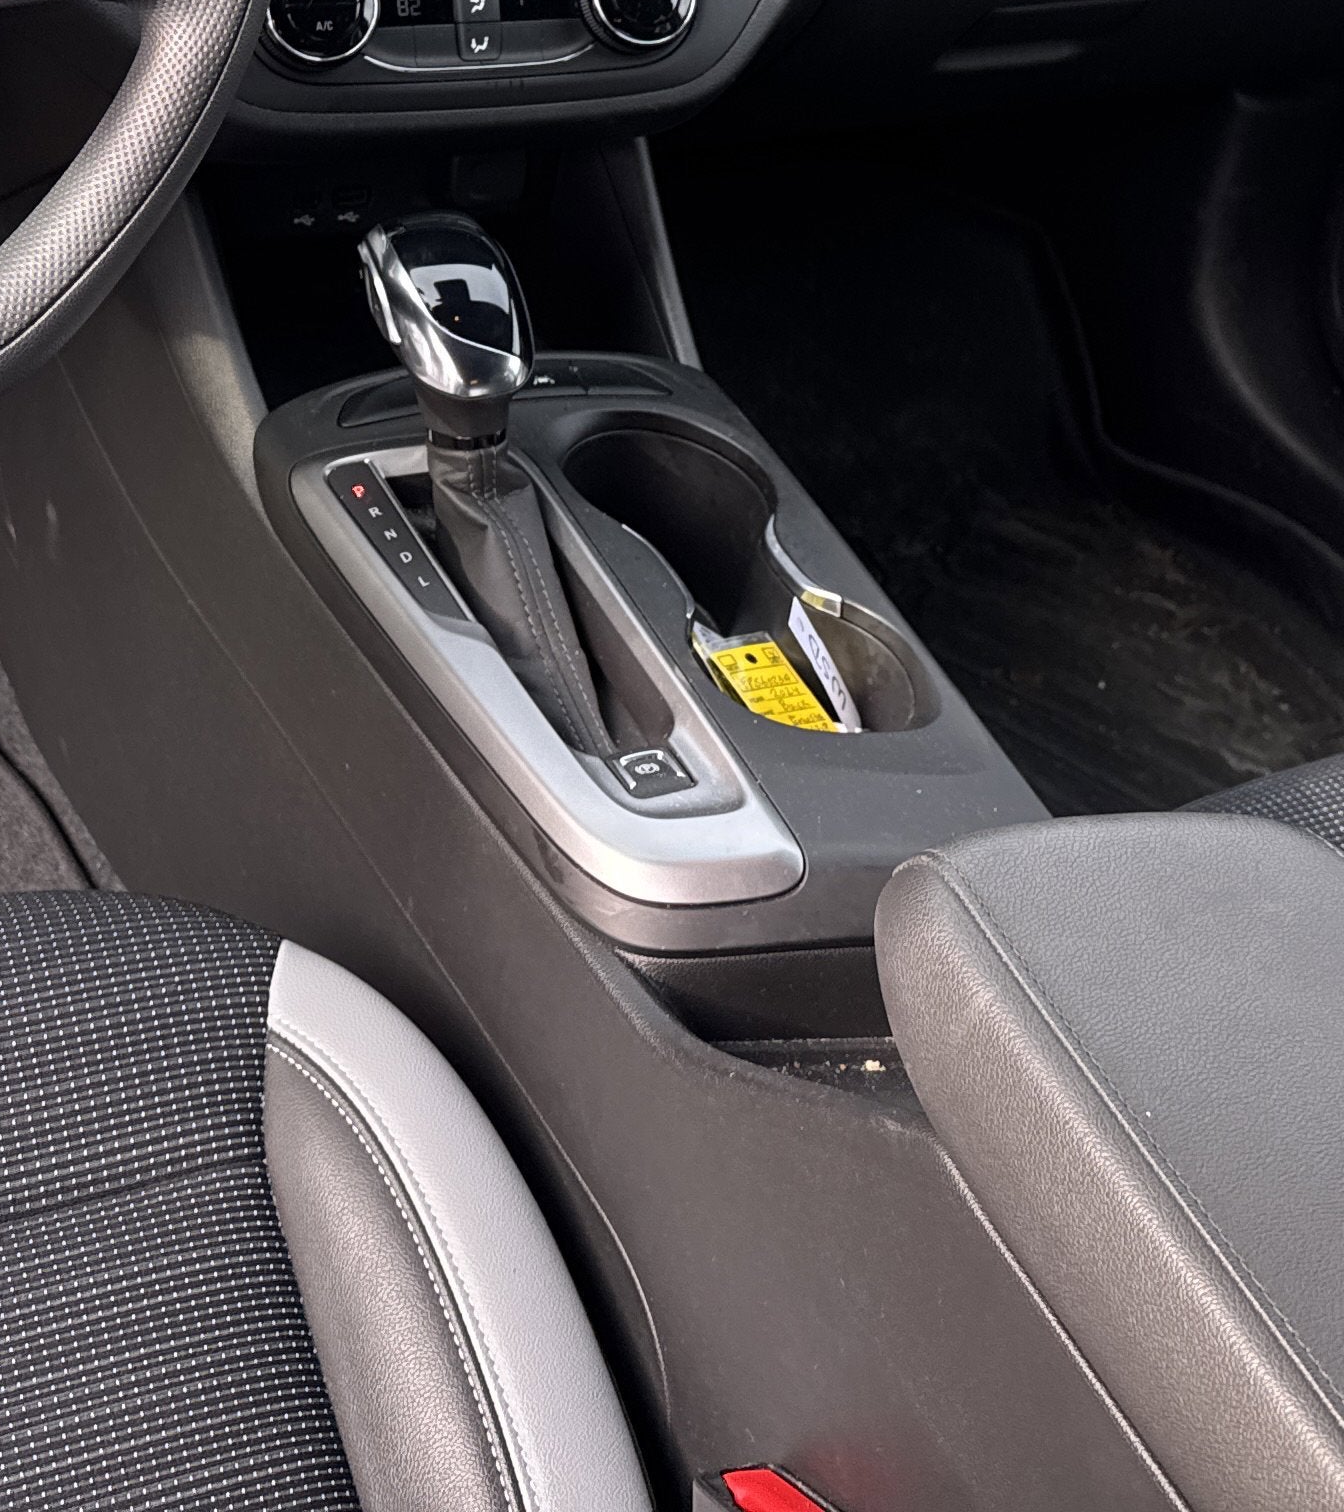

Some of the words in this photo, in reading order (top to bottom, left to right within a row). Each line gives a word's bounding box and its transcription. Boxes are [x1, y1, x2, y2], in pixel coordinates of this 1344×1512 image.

[316, 20, 333, 31] A/C
[352, 485, 365, 498] P
[368, 506, 383, 518] R
[383, 528, 398, 541] N
[399, 551, 413, 564] D
[417, 576, 430, 588] L
